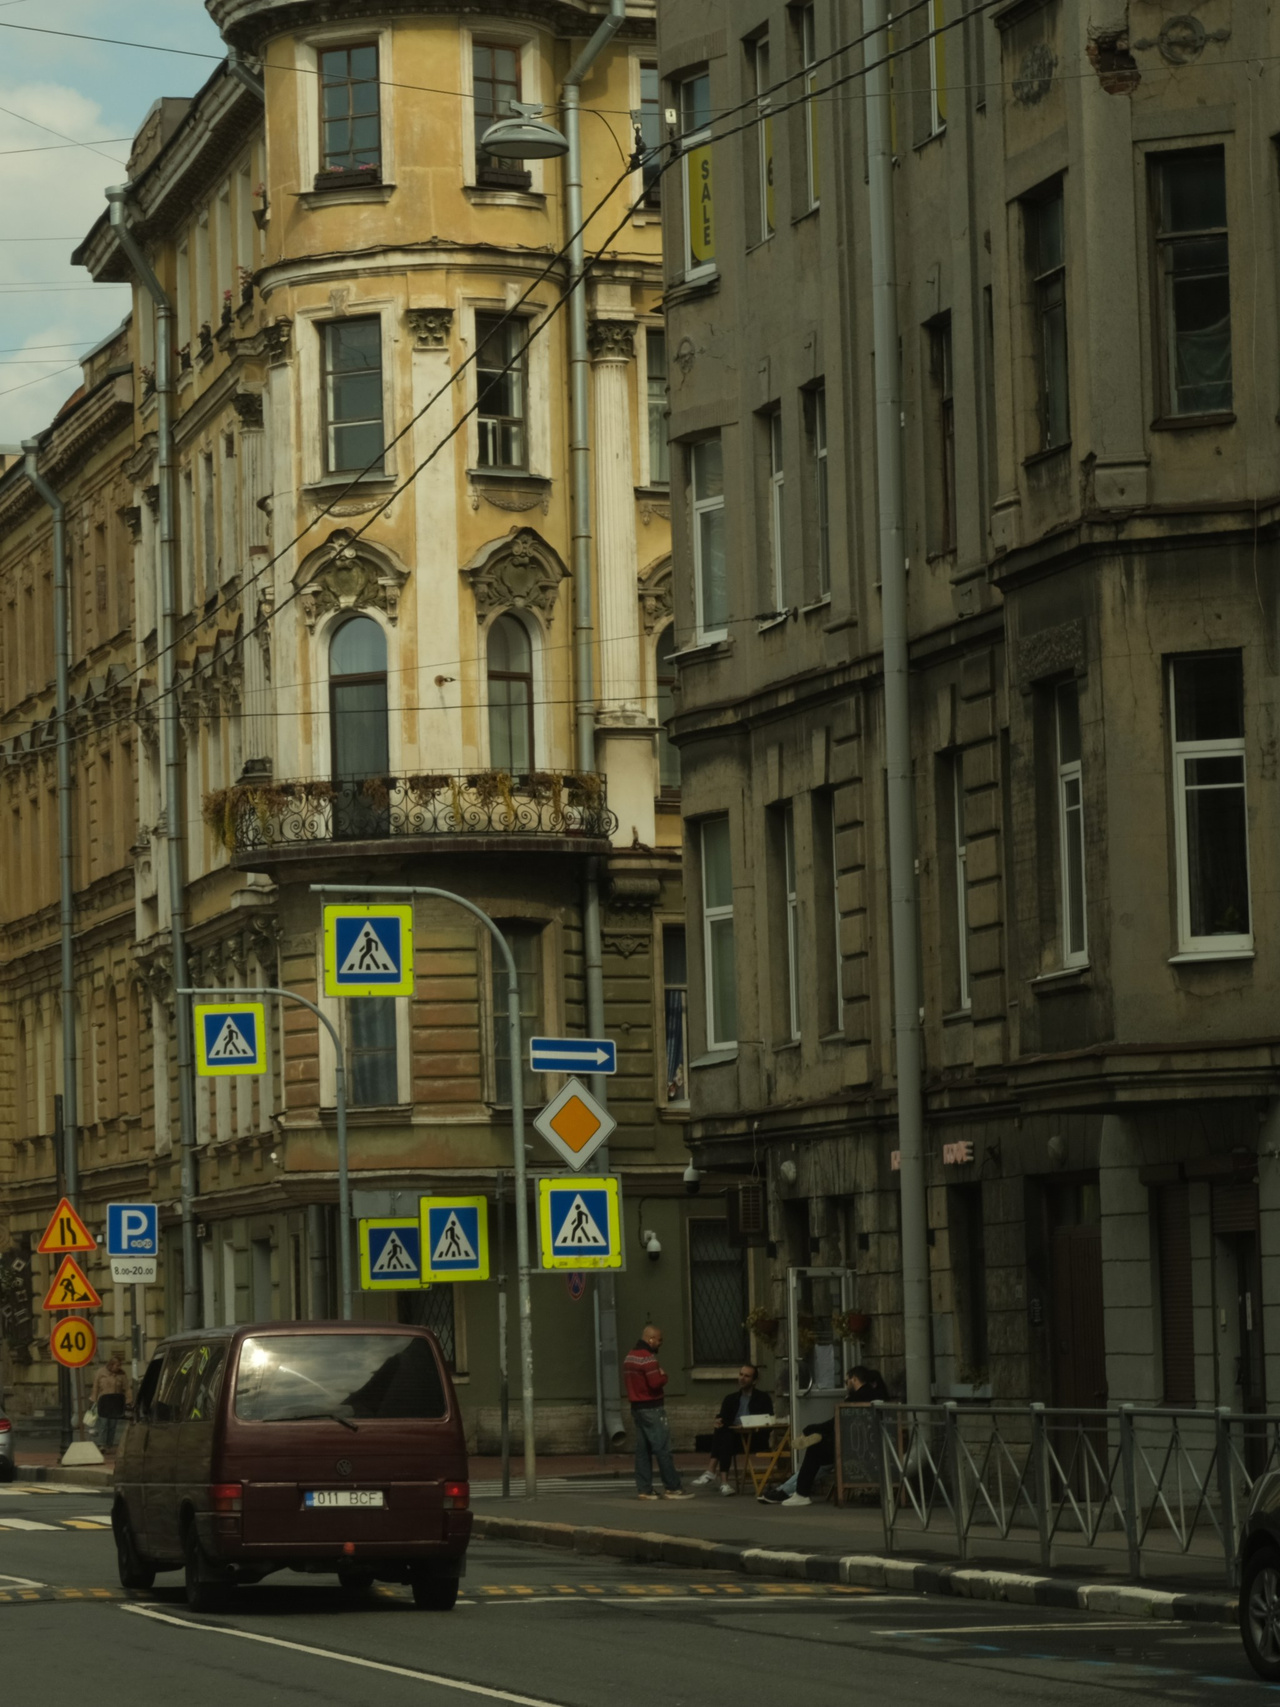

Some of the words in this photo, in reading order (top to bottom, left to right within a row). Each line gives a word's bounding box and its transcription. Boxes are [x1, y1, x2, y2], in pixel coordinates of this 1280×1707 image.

[701, 159, 711, 246] SALE
[121, 1210, 148, 1250] P
[114, 1266, 154, 1275] 8.00-20.00
[60, 1332, 86, 1352] 40
[317, 1492, 338, 1505] 011
[349, 1492, 377, 1505] BCF
